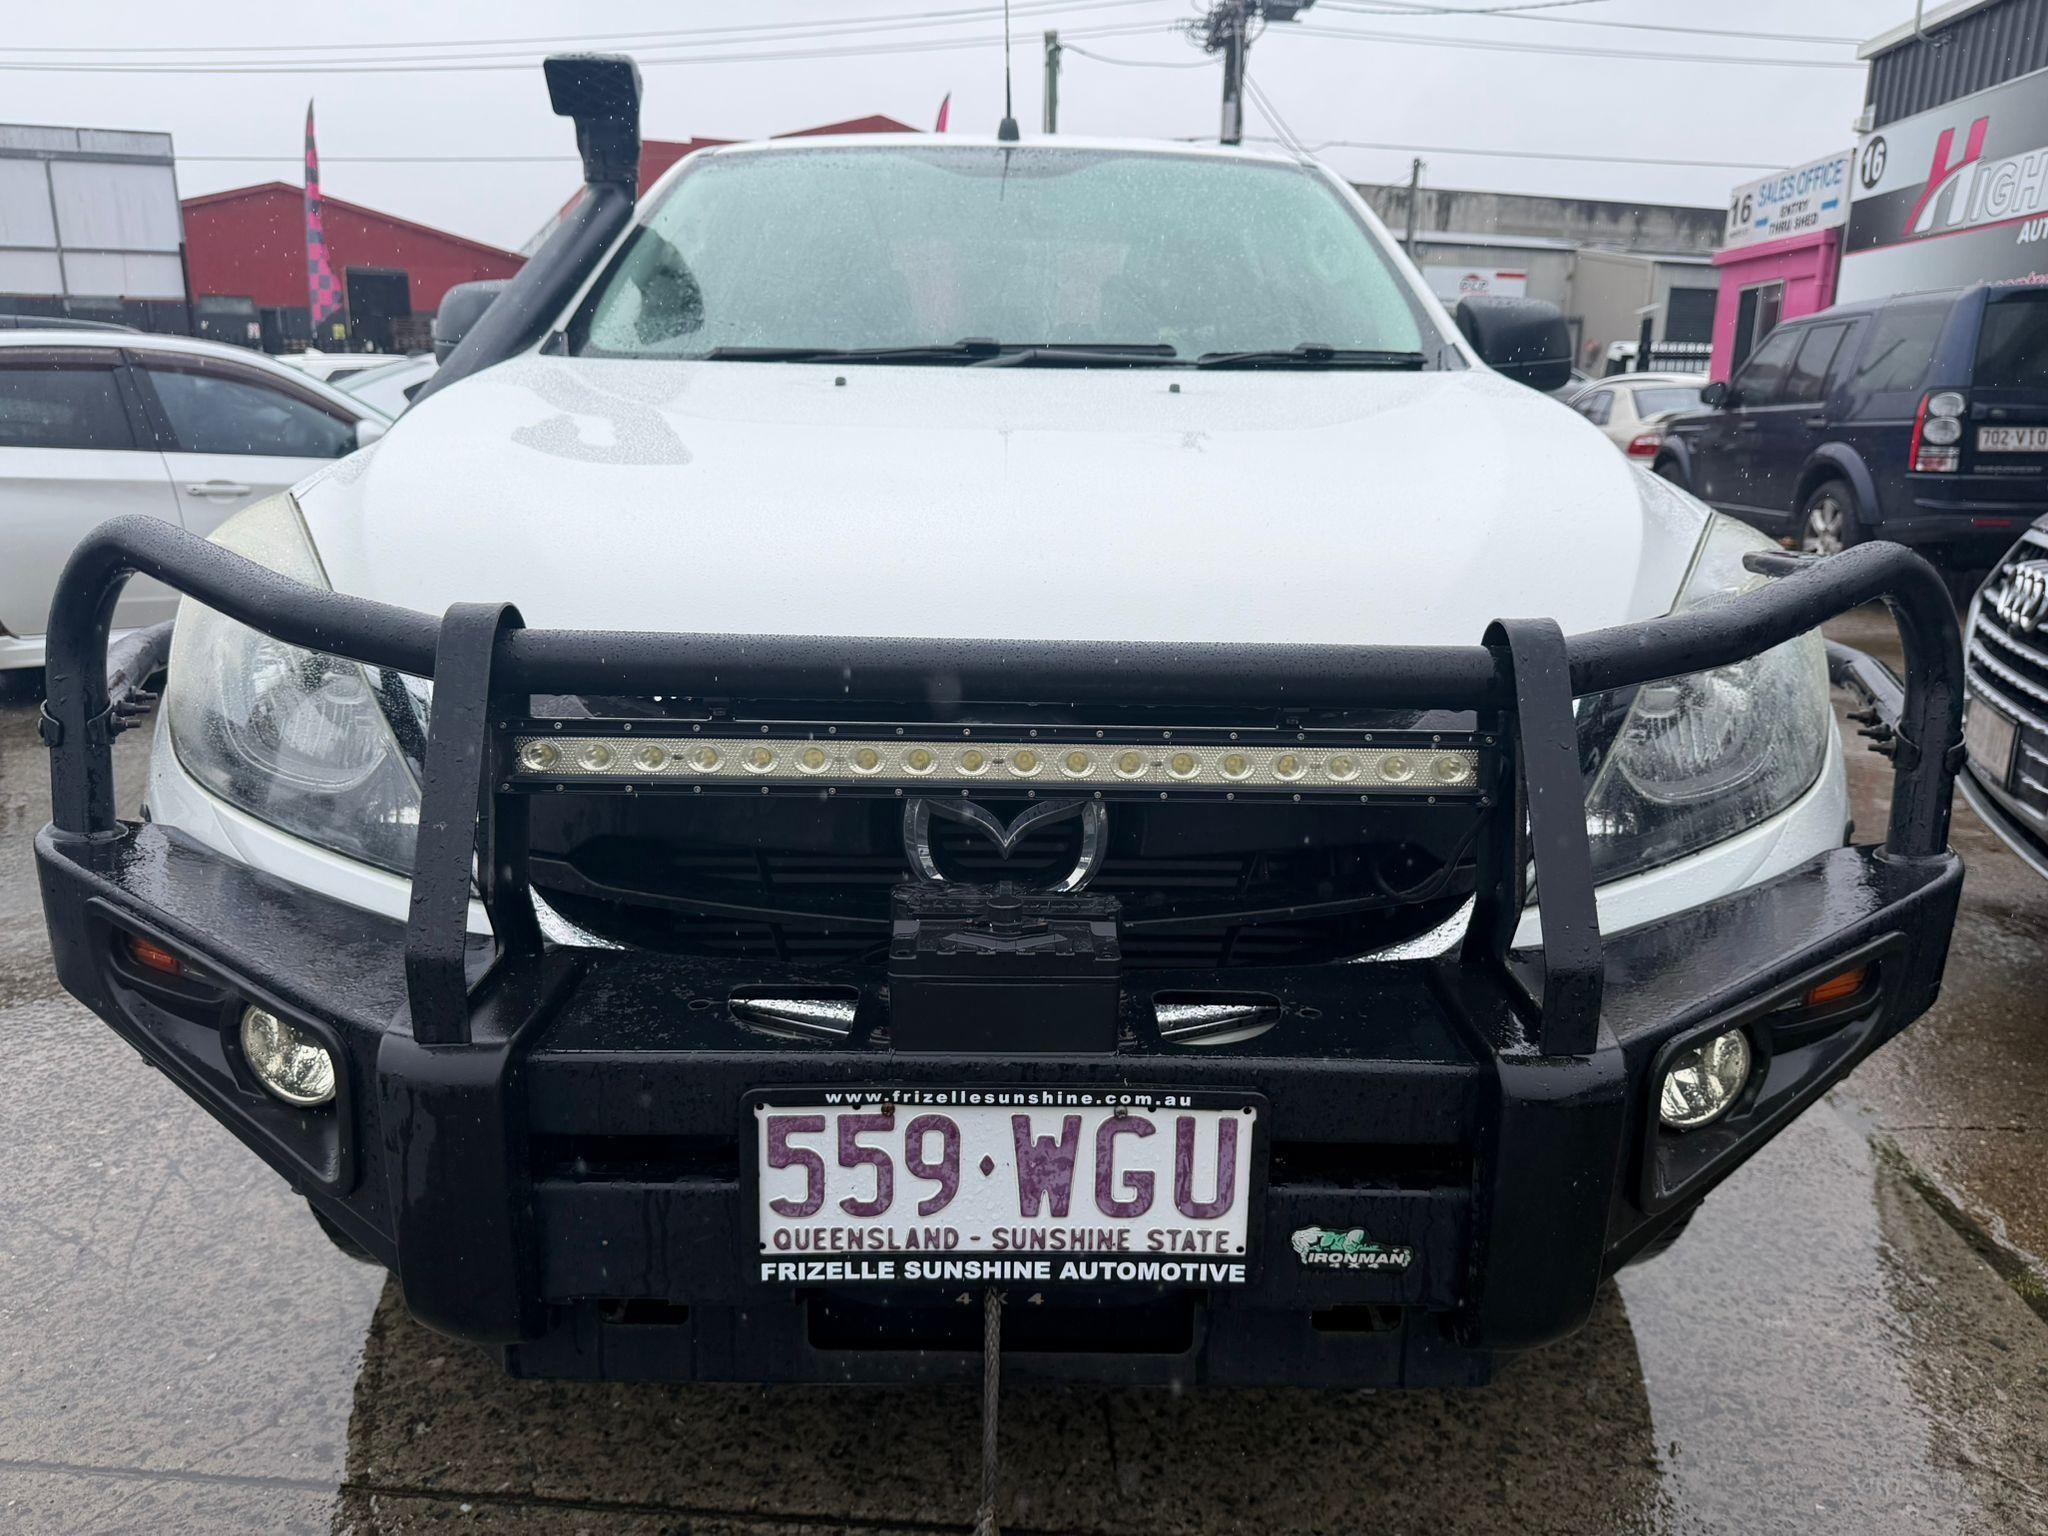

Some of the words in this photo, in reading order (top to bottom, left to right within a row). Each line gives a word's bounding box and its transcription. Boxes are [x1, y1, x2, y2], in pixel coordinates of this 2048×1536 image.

[1863, 141, 1886, 186] 16
[1758, 175, 1796, 207] SALES
[1796, 159, 1848, 196] OFFICE
[1728, 193, 1753, 228] 16
[1780, 199, 1809, 219] ENTRY
[1768, 219, 1791, 236] THRU
[1794, 212, 1818, 231] SHED
[825, 1091, 1192, 1107] www.frizellesunshine.com.au
[773, 1226, 960, 1251] QUEENSLAND
[991, 1227, 1131, 1251] SUNSHINE
[1147, 1228, 1230, 1254] STATE
[1307, 1252, 1406, 1264] IRONMAN
[760, 1261, 896, 1281] FRIZELLE
[904, 1260, 1051, 1280] SUNSHINE
[1059, 1261, 1246, 1282] AUTOMOTIVE
